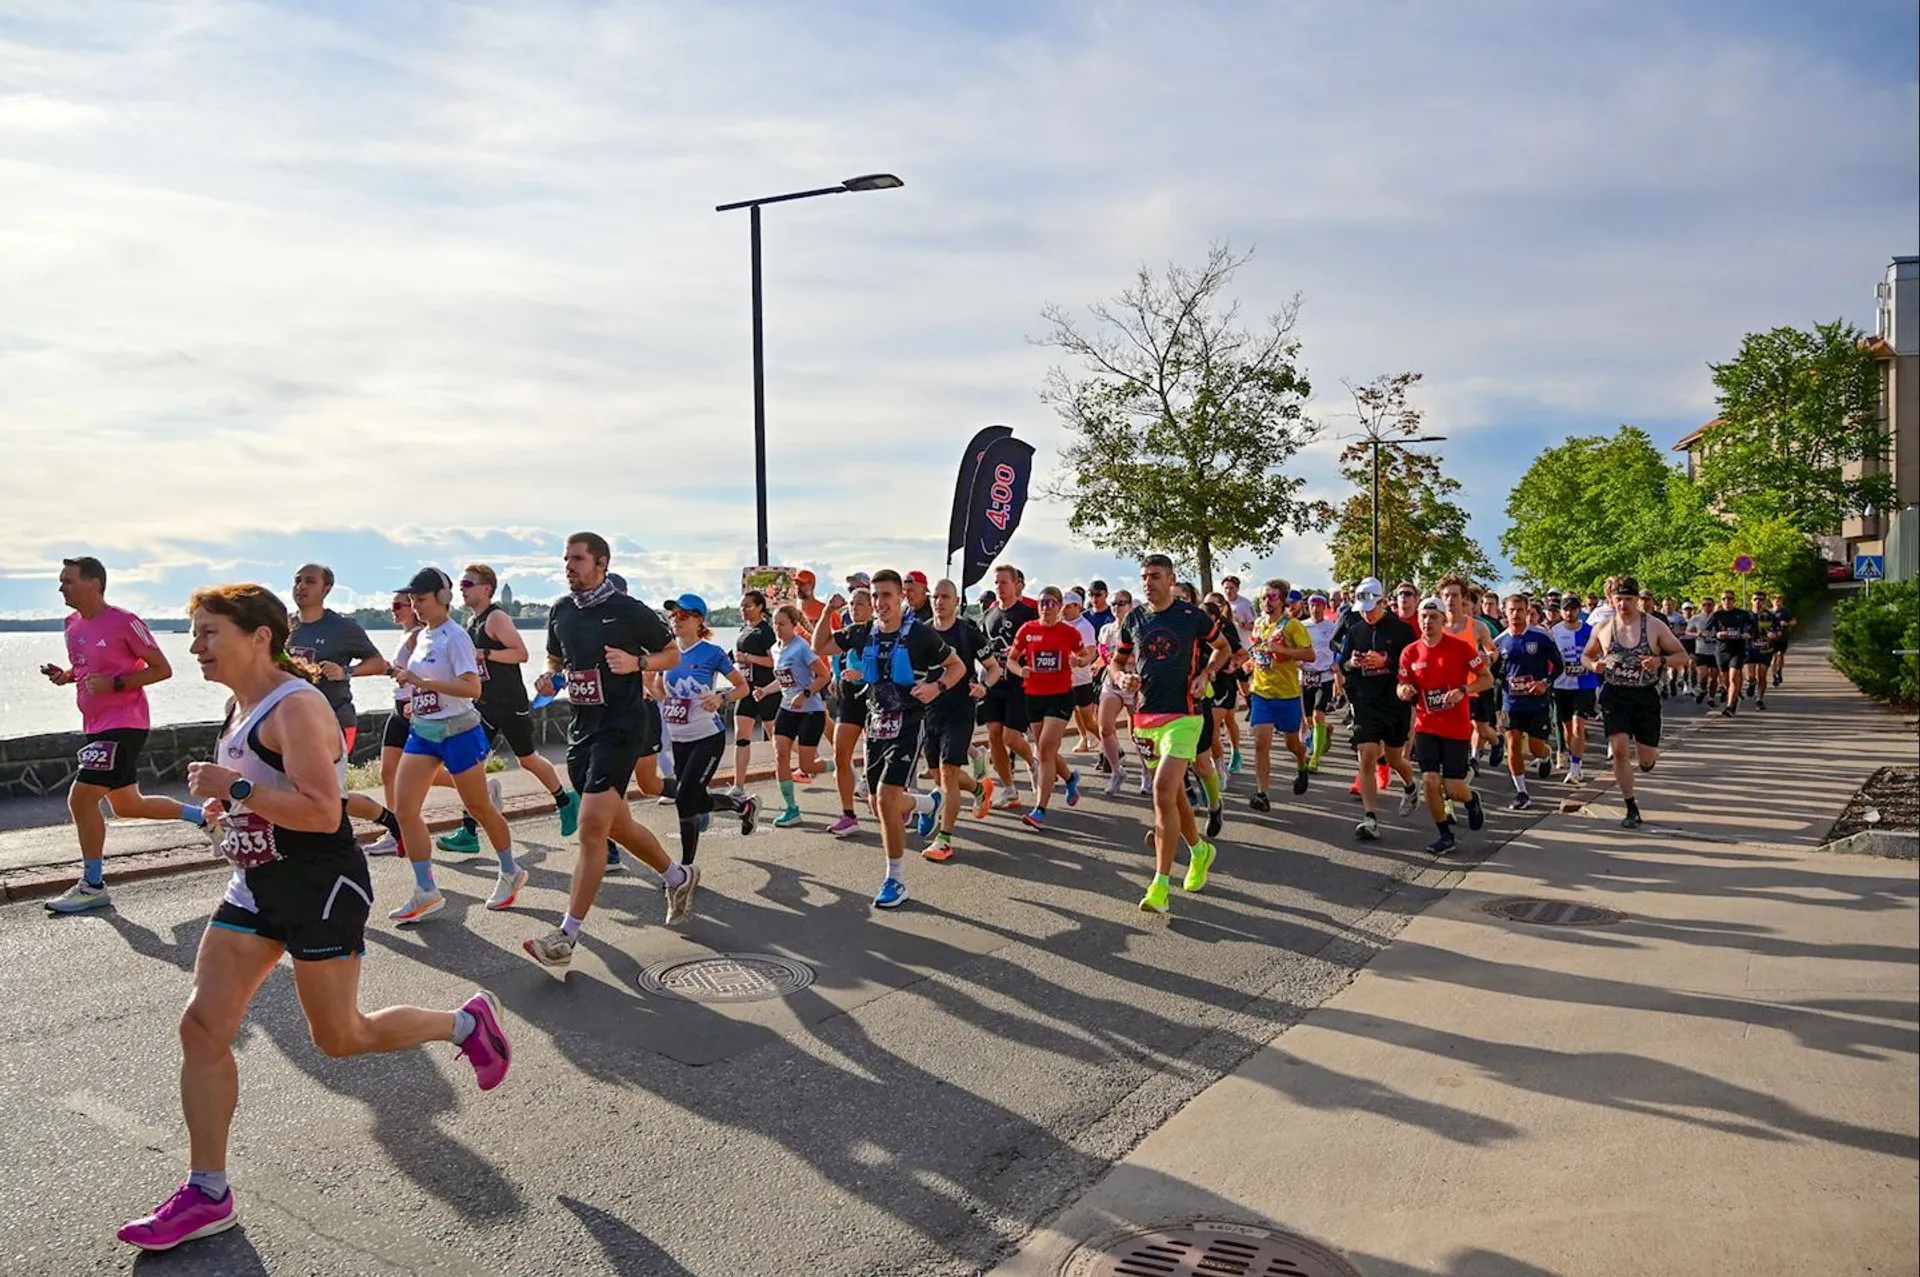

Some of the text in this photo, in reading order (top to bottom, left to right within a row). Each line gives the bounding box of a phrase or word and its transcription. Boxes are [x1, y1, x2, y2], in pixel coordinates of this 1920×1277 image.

[986, 463, 1015, 530] 4:00
[1037, 657, 1056, 667] 7015
[663, 705, 687, 718] 7269
